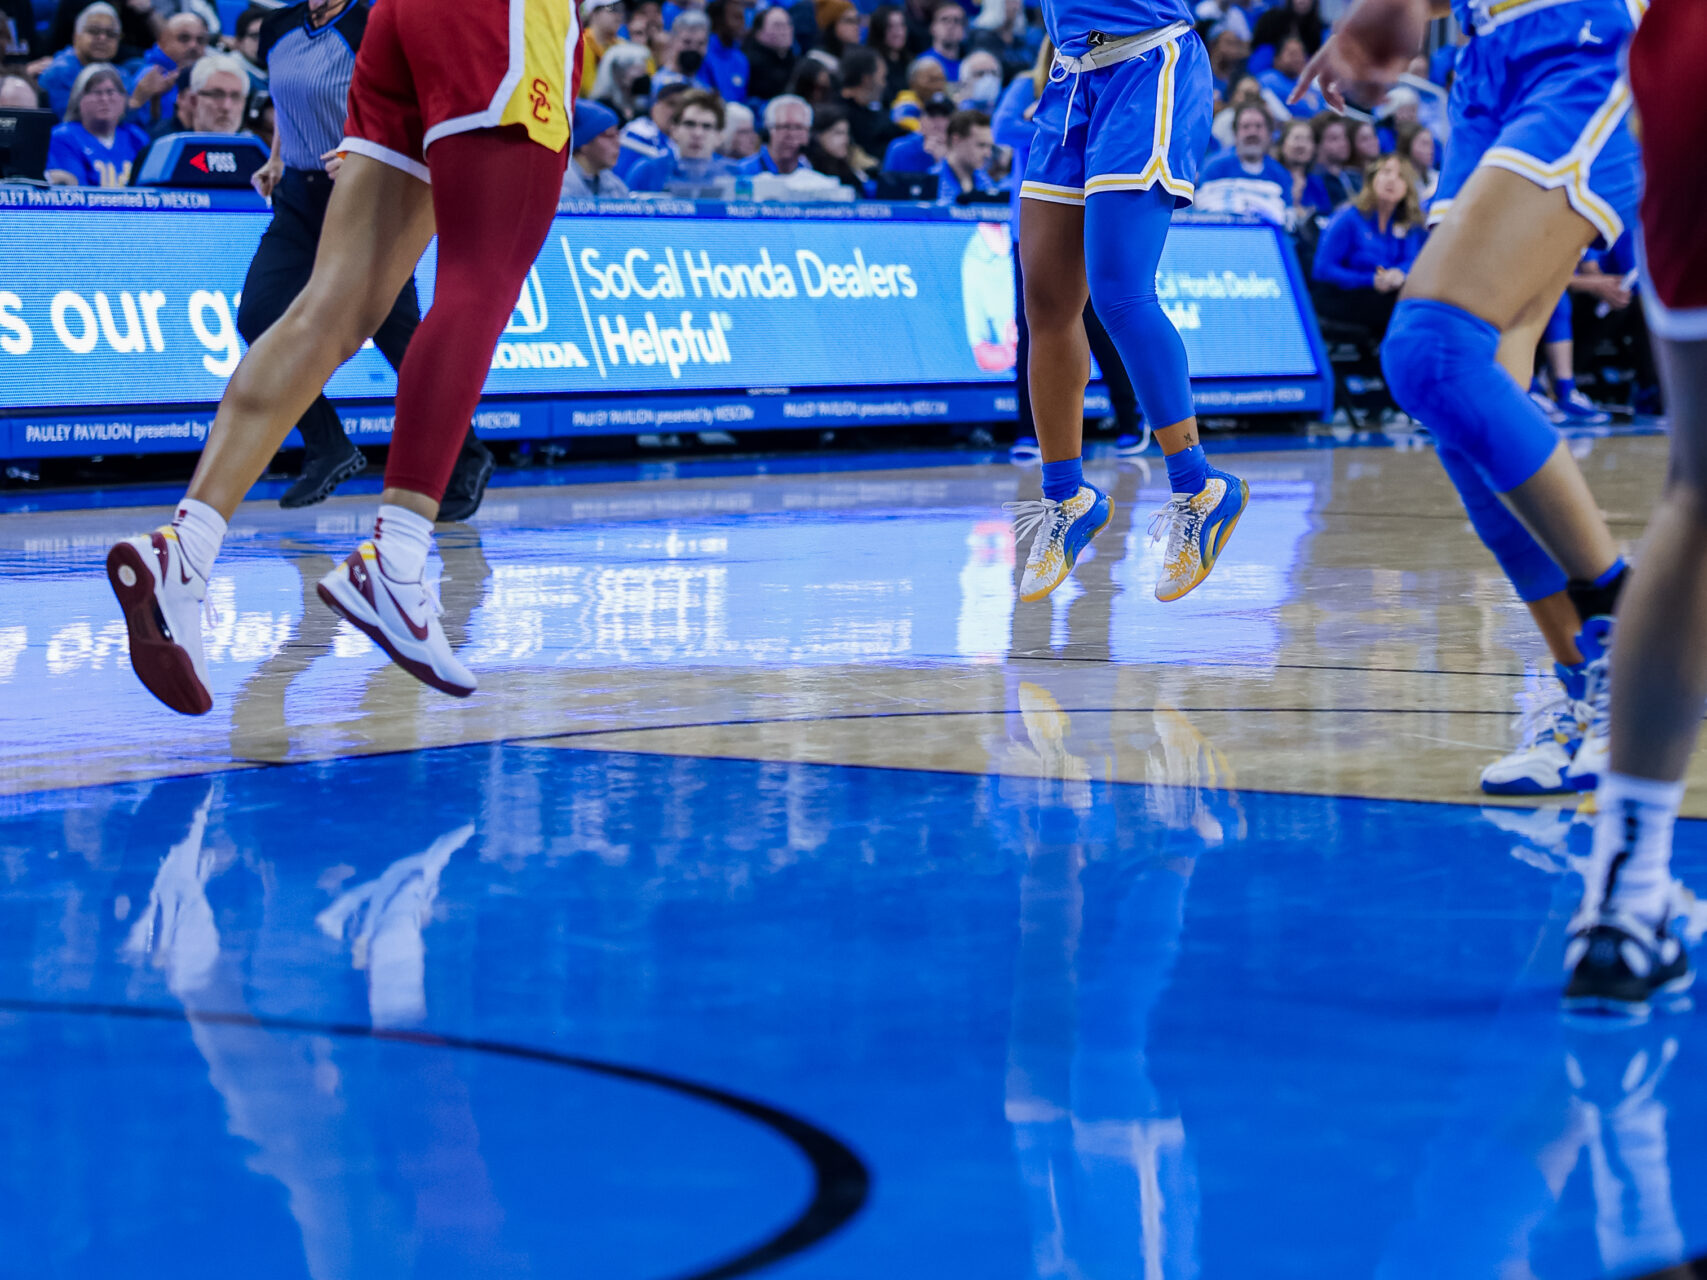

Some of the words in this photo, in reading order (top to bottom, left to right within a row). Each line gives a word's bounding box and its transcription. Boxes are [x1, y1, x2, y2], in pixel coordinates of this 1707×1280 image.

[28, 191, 85, 207] PAVILION
[87, 192, 143, 208] presented
[145, 193, 160, 208] by
[580, 247, 685, 299] SoCal
[684, 247, 798, 299] Honda
[796, 247, 918, 299] Dealers
[51, 290, 166, 354] our
[599, 311, 732, 378] Helpful
[26, 424, 72, 442] PAULEY
[73, 423, 132, 441] PAVILION
[134, 421, 190, 443] presented
[192, 420, 207, 441] by
